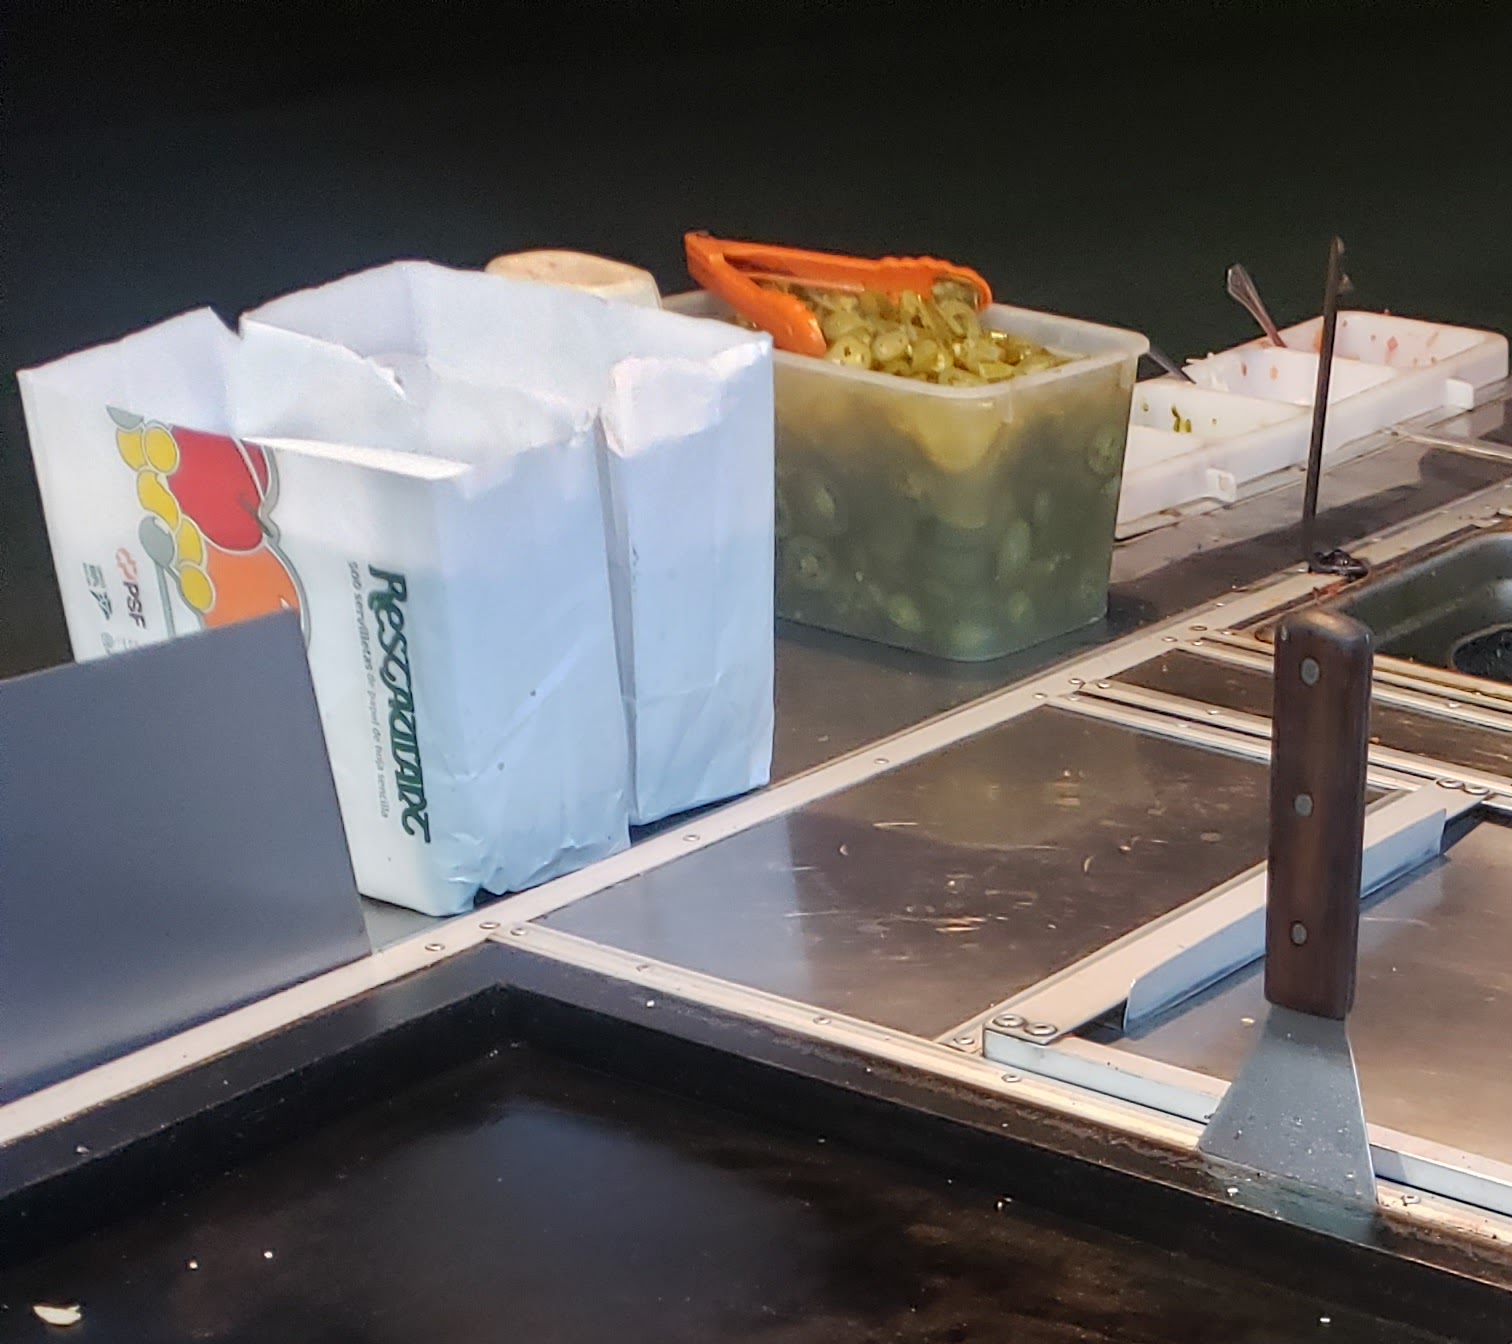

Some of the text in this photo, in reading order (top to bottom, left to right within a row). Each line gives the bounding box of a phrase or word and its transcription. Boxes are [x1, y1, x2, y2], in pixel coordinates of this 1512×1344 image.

[123, 580, 147, 630] PSF
[353, 592, 374, 671] servilletas
[367, 689, 381, 726] papel
[376, 772, 390, 819] sencilla
